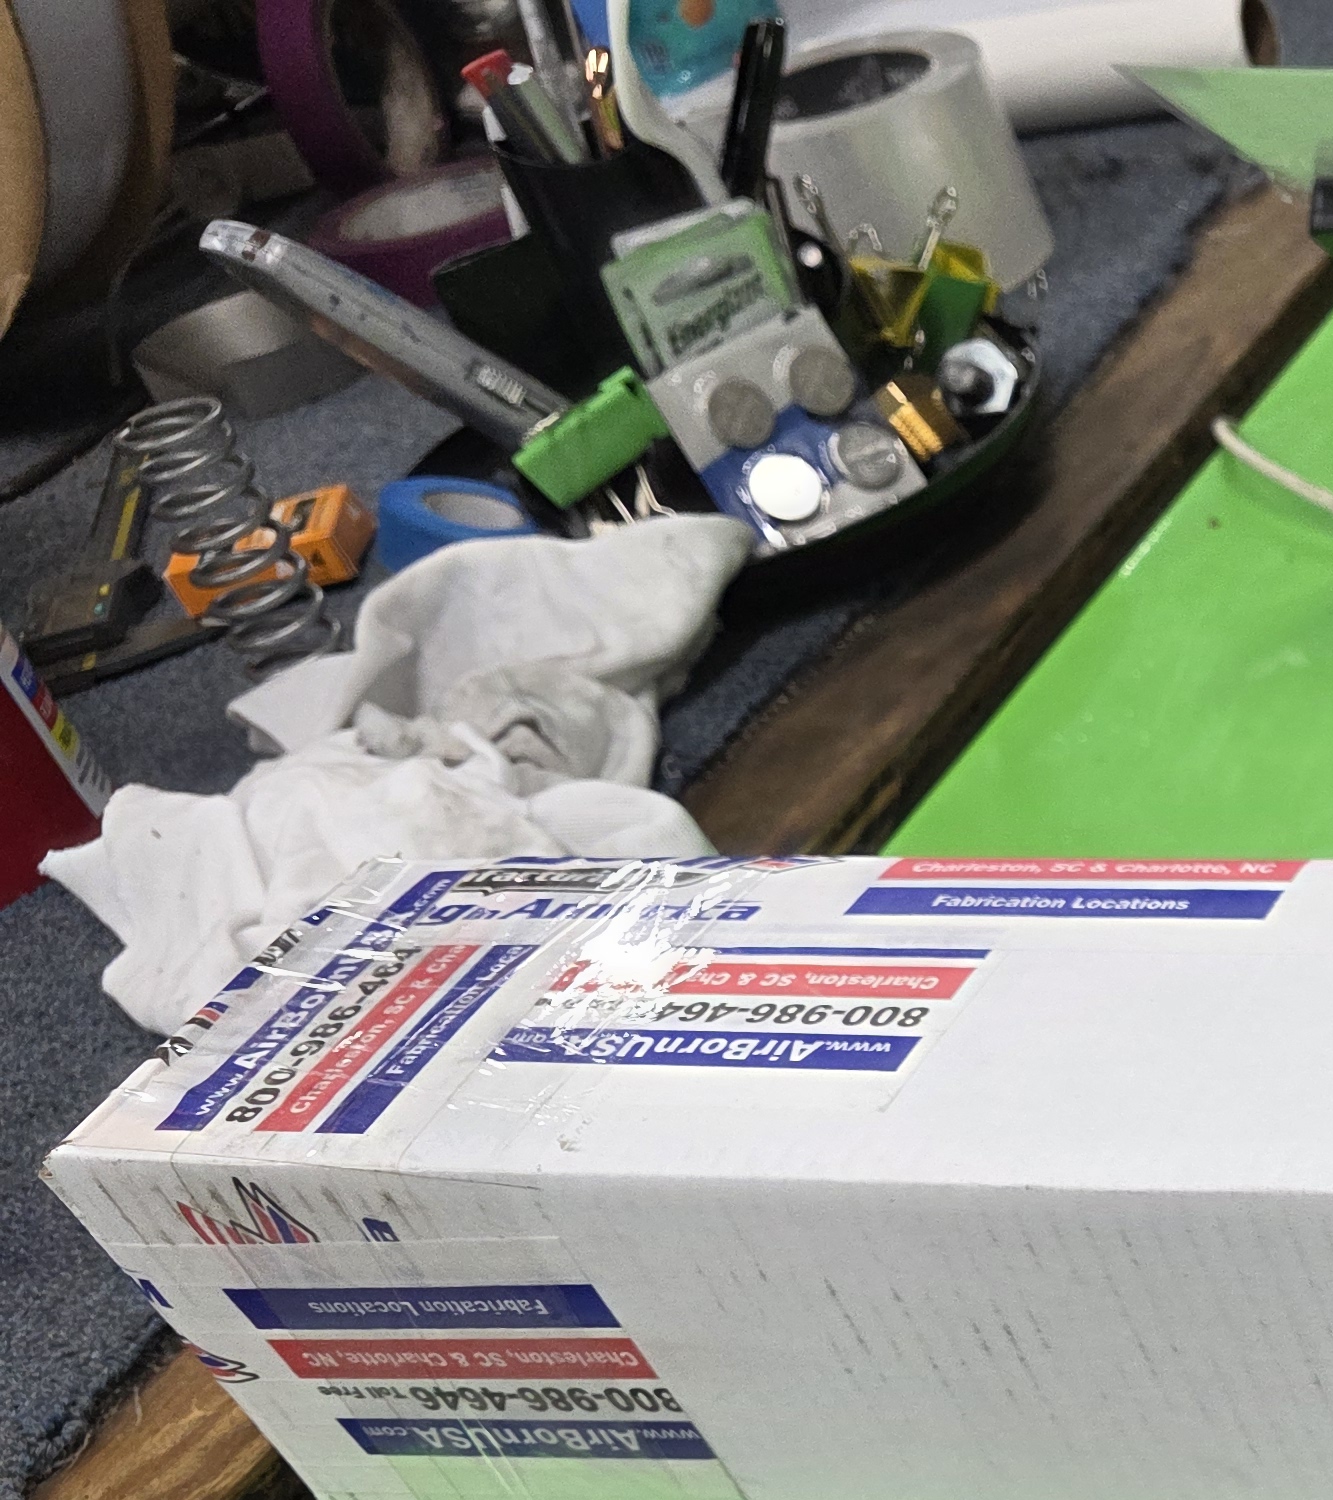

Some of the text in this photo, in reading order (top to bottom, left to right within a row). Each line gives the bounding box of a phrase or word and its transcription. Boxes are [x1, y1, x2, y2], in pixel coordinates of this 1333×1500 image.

[931, 894, 1191, 911] Fabrication Locations
[760, 972, 797, 987] SC
[805, 972, 940, 991] Charleston,
[307, 1299, 551, 1317] Fabrication Locations
[301, 1351, 334, 1368] NC
[474, 1350, 507, 1368] SC
